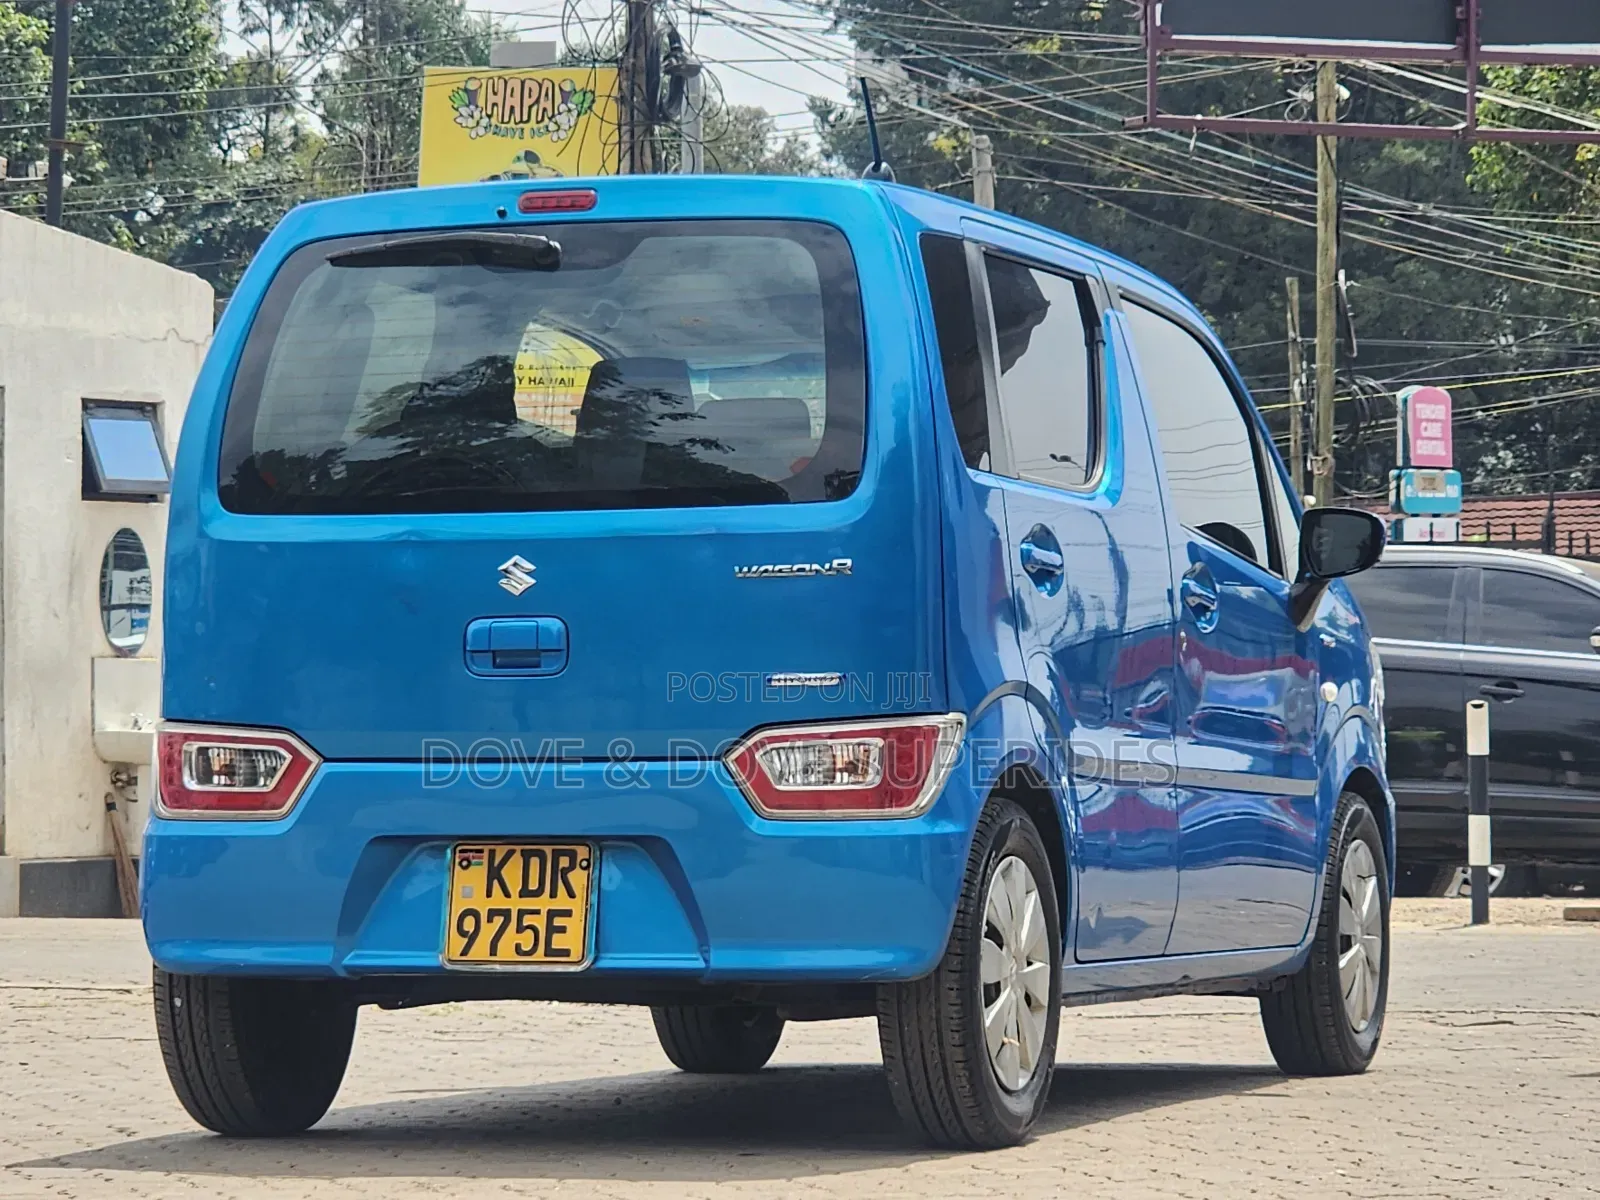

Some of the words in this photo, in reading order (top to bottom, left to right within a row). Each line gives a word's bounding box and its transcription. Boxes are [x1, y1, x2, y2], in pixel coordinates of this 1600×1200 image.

[485, 76, 555, 124] HAPA
[486, 848, 578, 899] KDR
[456, 908, 573, 958] 975E
